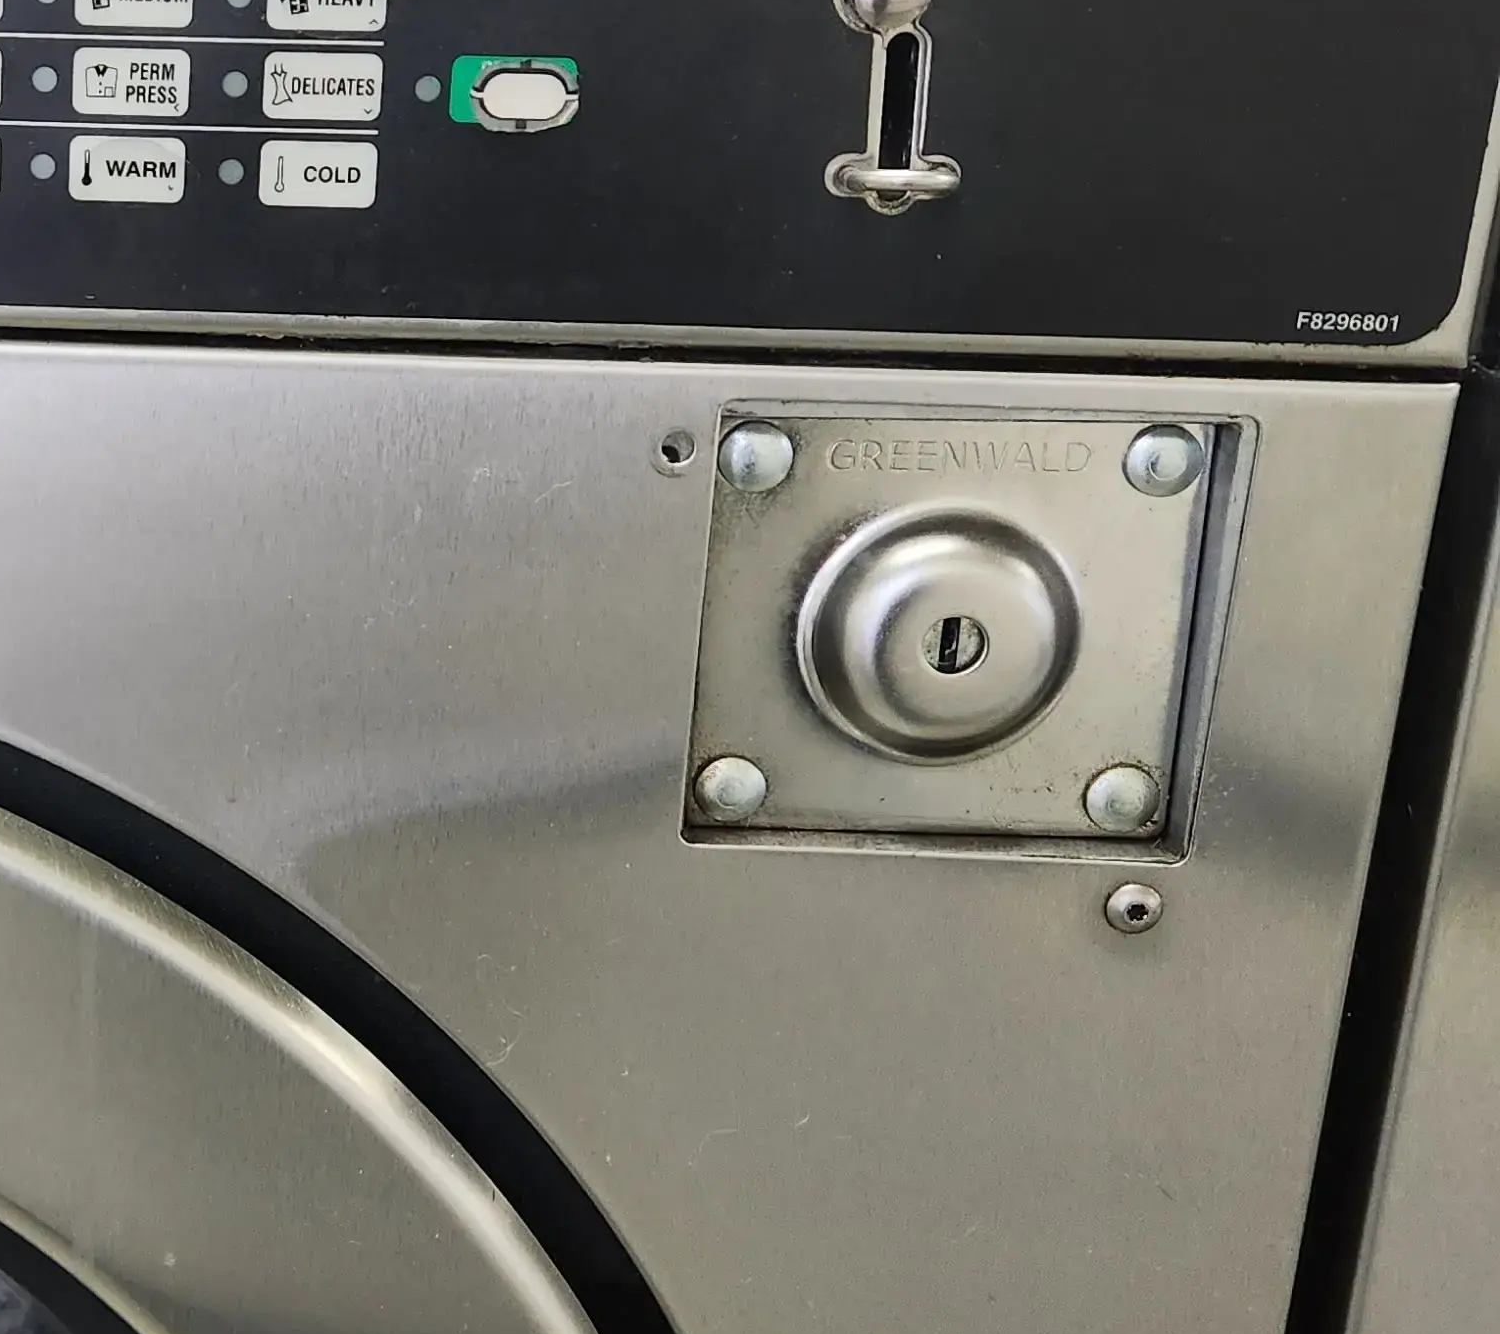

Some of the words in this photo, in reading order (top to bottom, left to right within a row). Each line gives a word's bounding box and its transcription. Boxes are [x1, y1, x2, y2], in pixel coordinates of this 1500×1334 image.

[128, 63, 176, 82] PERM
[125, 85, 178, 107] PRESS
[290, 76, 376, 98] DELICATES
[105, 160, 177, 180] WARM
[303, 165, 362, 185] COLD
[1296, 311, 1402, 334] F8296801
[827, 437, 1094, 474] GREENWALD
